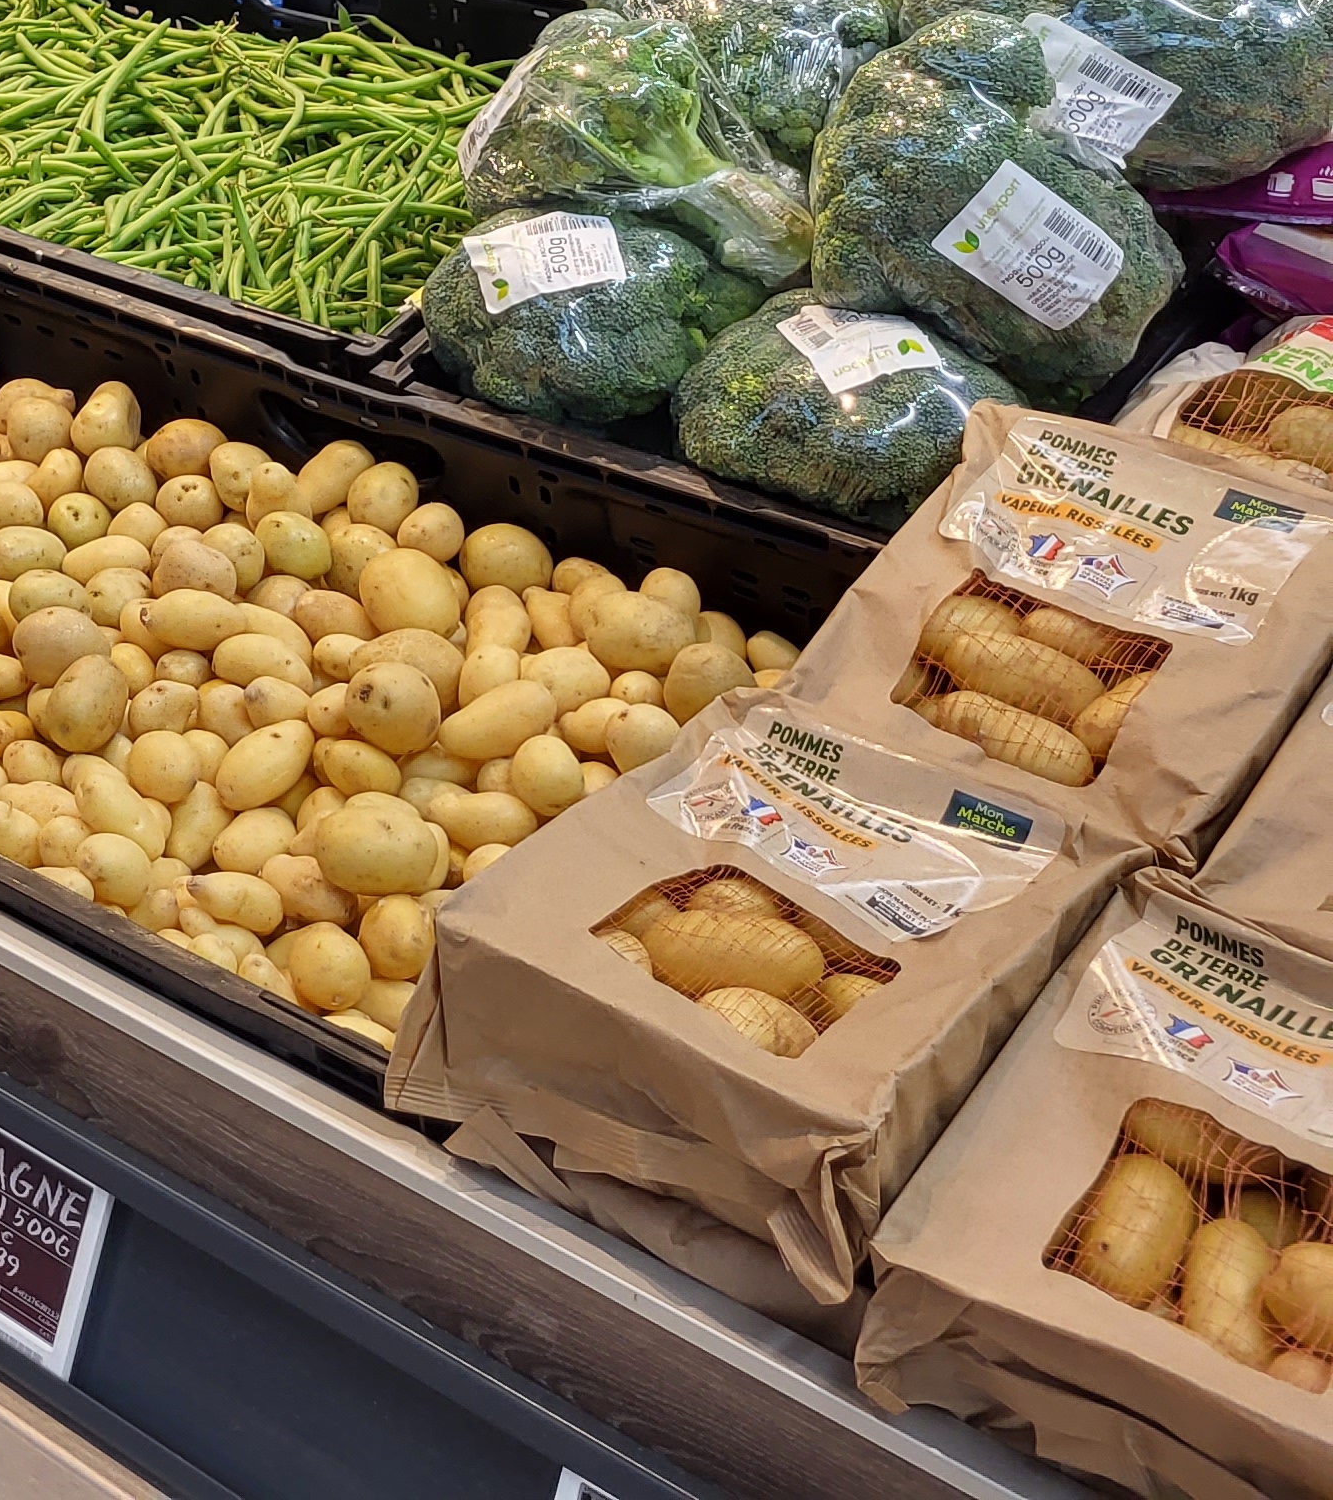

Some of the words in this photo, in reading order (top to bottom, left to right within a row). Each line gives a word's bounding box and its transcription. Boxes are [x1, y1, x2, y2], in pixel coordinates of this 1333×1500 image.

[975, 176, 1022, 231] unexport
[548, 236, 570, 275] 500g
[1016, 245, 1066, 289] 500g
[1039, 428, 1118, 467] POMMES
[1000, 493, 1062, 520] VAPEUR,
[1066, 507, 1156, 550] RISSOLÉES
[1015, 460, 1195, 536] GRENAILLES
[1247, 497, 1278, 515] Mon
[1229, 586, 1259, 607] 1kg
[756, 741, 784, 766] DE
[791, 752, 841, 785] TERRE
[767, 719, 844, 765] POMMES
[720, 752, 783, 802] VAPEUR,
[741, 746, 914, 844] GRENAILLES
[955, 807, 1017, 838] Marché
[973, 800, 1005, 822] Mon
[1163, 937, 1197, 959] DE
[1196, 952, 1270, 992] TERRE
[1174, 914, 1265, 968] POMMES
[1130, 960, 1206, 1015] VAPEUR,
[1212, 1011, 1322, 1066] RISSOLÉES
[11, 1205, 72, 1259] 500G
